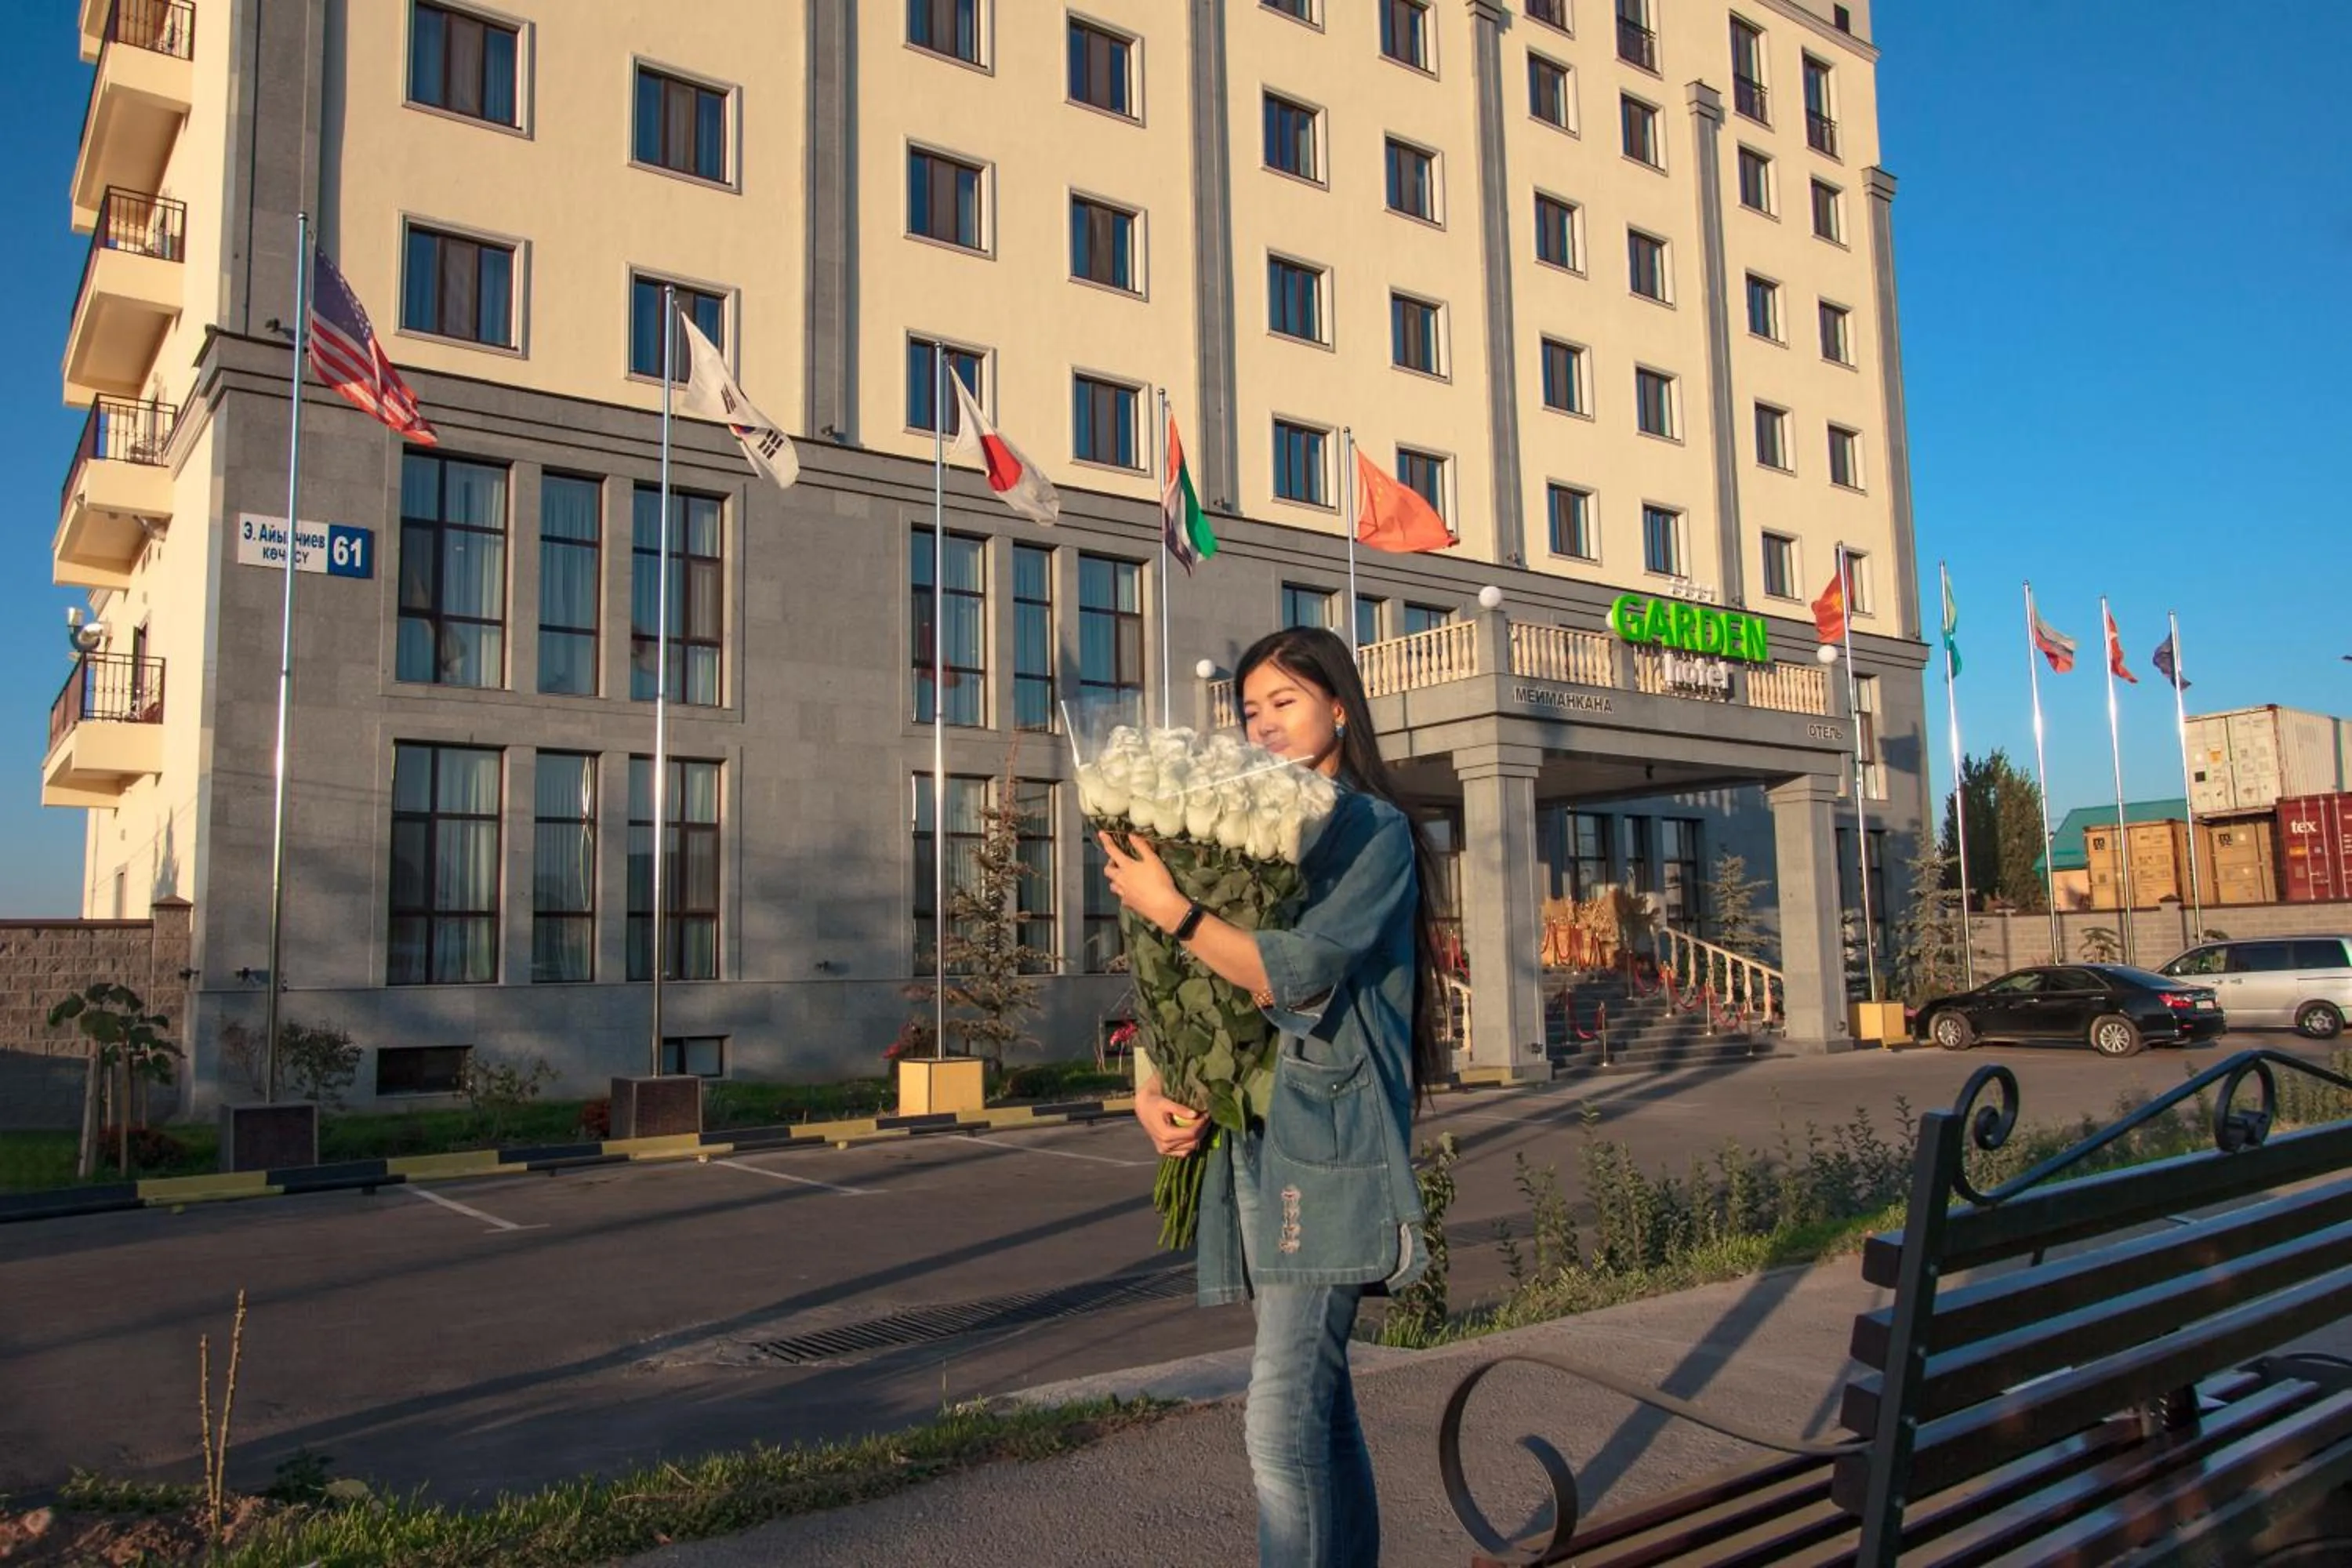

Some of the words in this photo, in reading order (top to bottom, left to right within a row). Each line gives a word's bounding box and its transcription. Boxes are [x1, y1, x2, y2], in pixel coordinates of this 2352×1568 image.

[243, 521, 257, 541] Э.
[259, 523, 326, 550] Айычиев
[263, 546, 310, 564] көчсү
[332, 535, 363, 568] 61
[1610, 594, 1769, 662] GARDEN
[1664, 652, 1730, 690] hotel
[1513, 685, 1614, 714] МЕЙМАНКАНА
[1807, 724, 1844, 740] ОТЕЛЬ
[2290, 818, 2317, 833] tex
